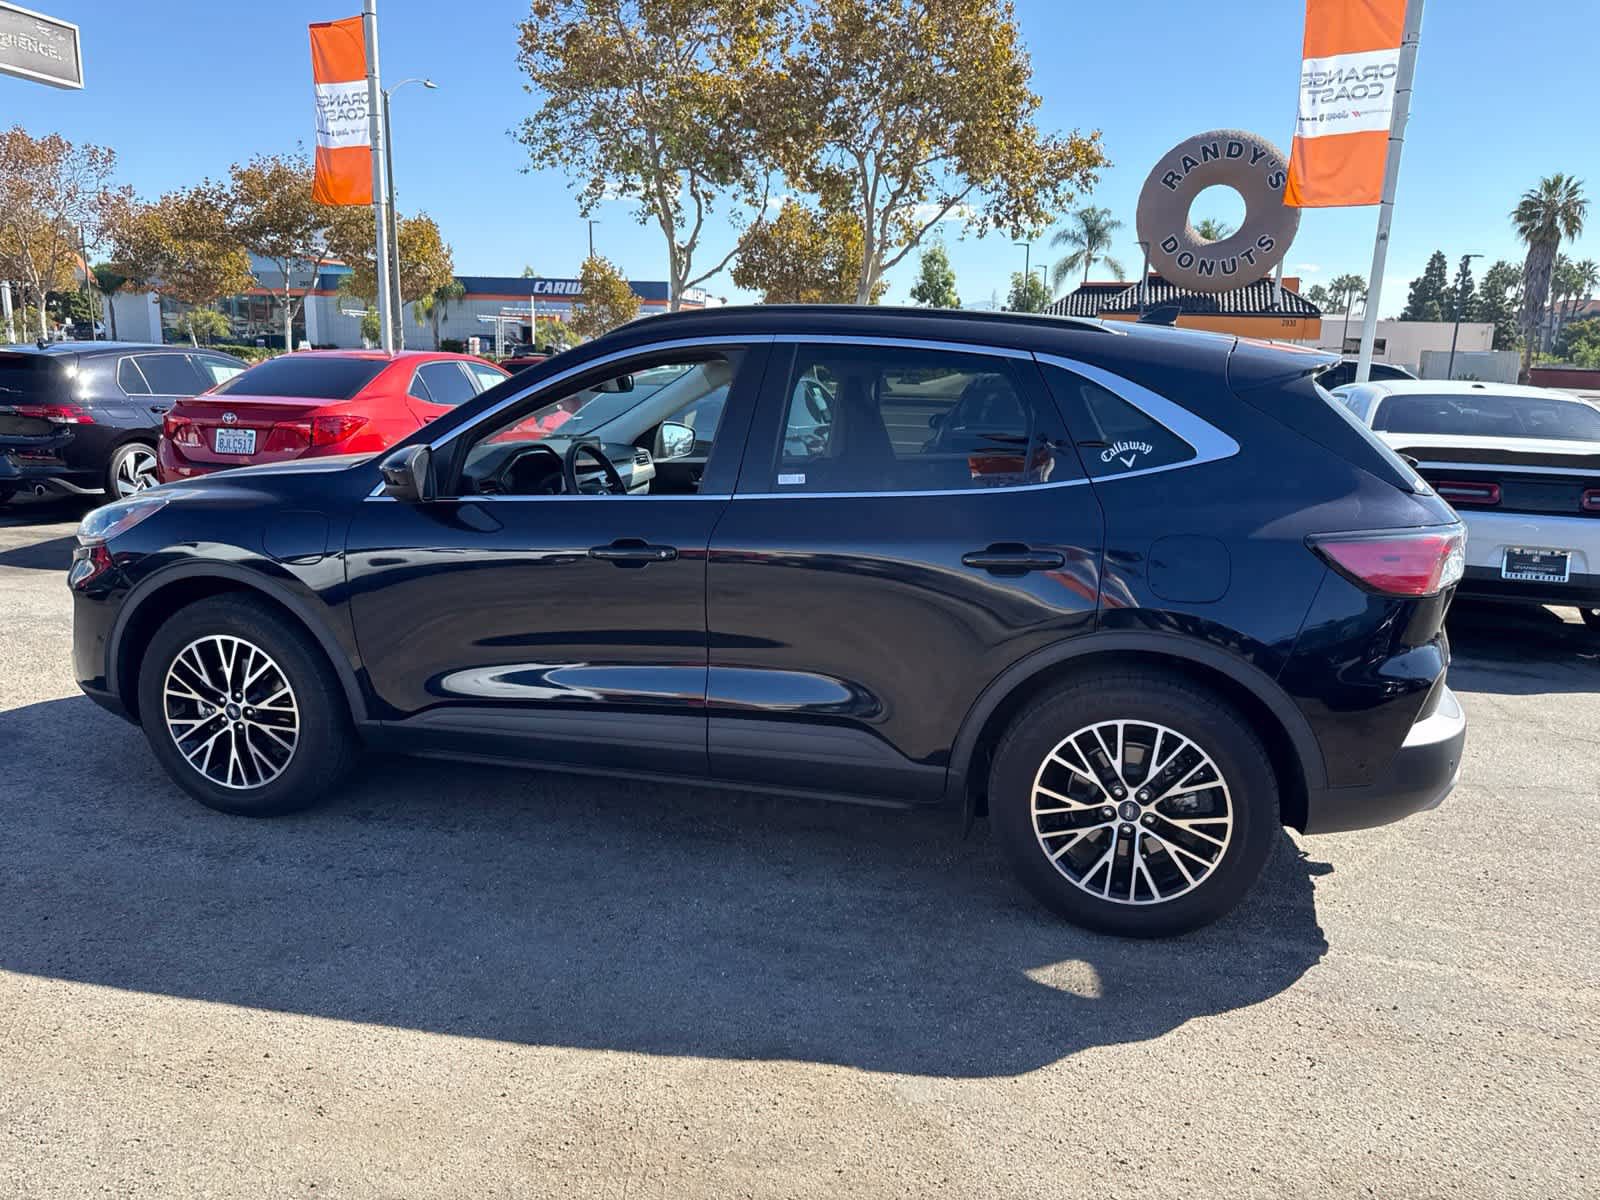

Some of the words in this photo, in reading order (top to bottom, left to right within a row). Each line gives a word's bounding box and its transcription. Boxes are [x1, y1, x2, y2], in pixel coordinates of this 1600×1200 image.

[1161, 140, 1287, 191] RANDY'S
[1160, 233, 1276, 277] DONUTS
[1101, 440, 1153, 462] Callaway
